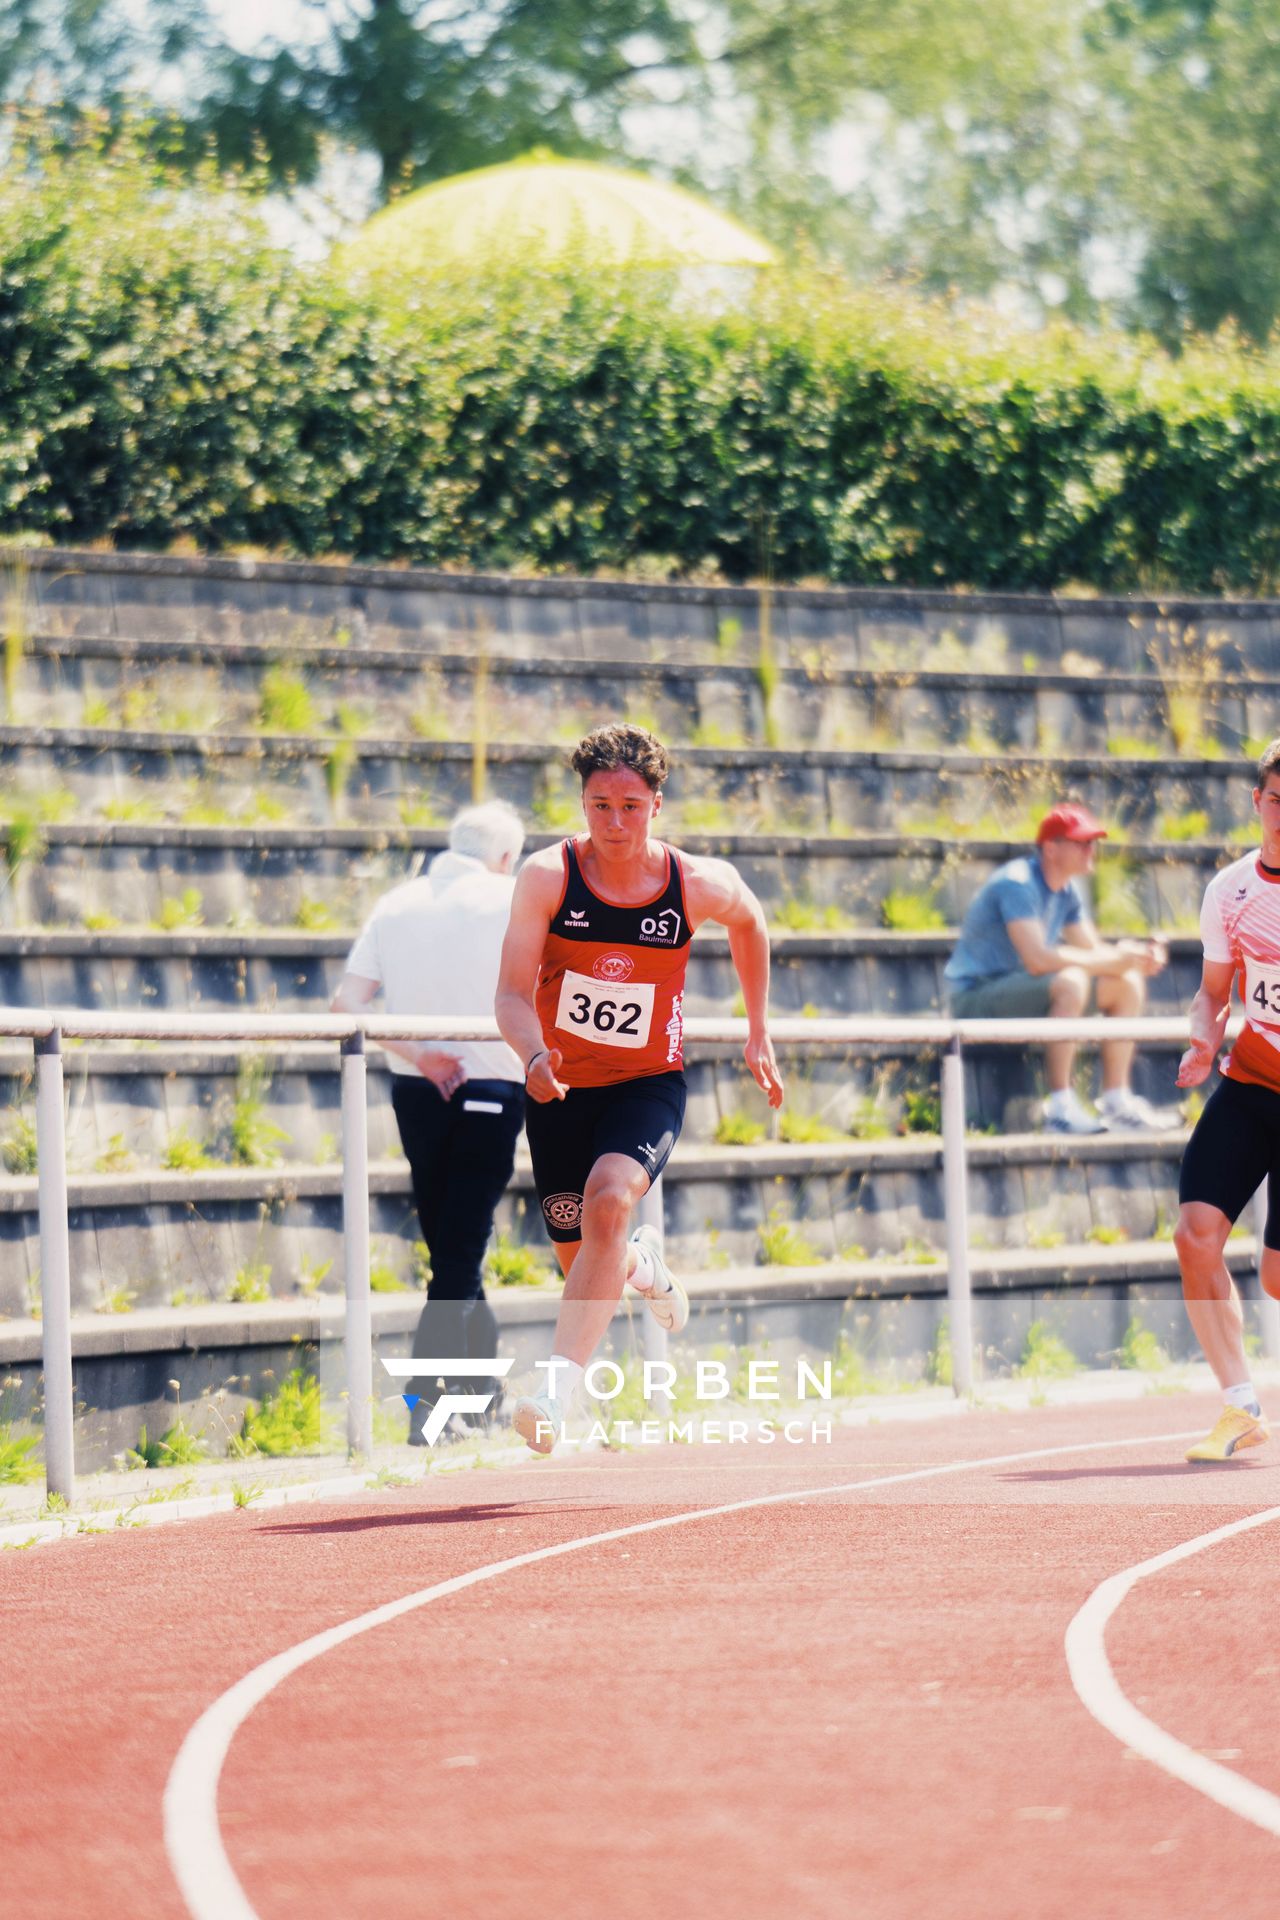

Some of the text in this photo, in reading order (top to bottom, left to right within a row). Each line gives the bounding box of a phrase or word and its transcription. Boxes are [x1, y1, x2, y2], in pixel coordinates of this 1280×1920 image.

[564, 919, 589, 928] erima
[640, 917, 669, 936] OS
[568, 993, 642, 1036] 362
[637, 1144, 656, 1163] erima
